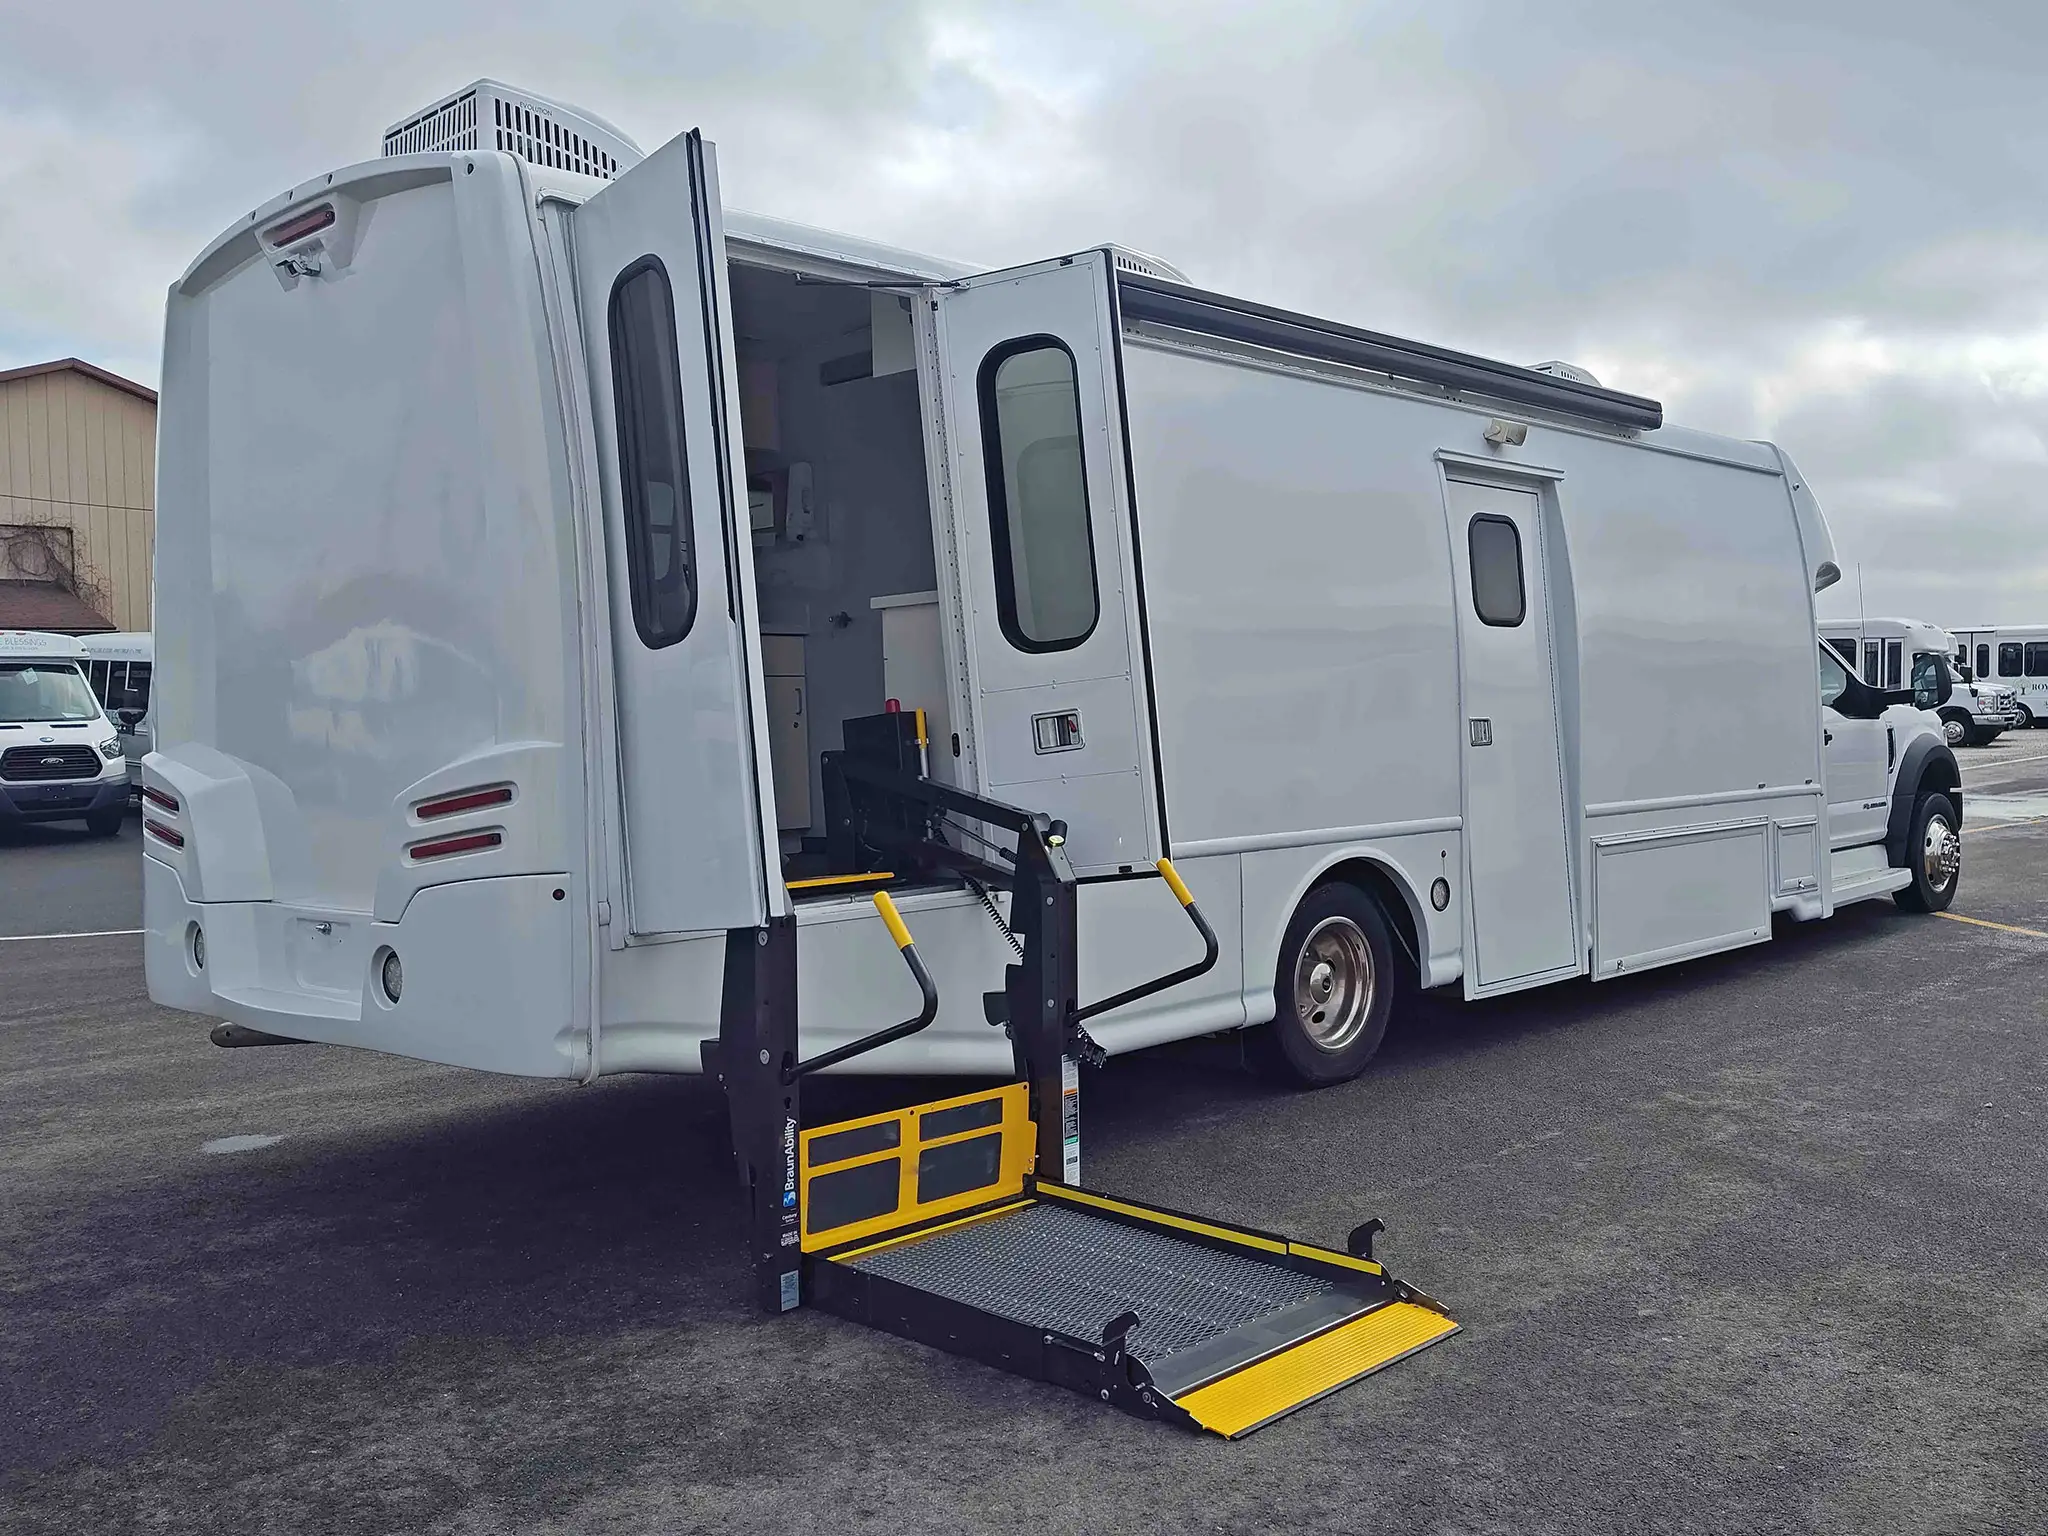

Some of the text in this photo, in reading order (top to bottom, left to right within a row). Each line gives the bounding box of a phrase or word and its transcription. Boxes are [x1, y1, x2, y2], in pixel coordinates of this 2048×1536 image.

[519, 101, 553, 116] EVOLUTION
[4, 636, 47, 646] BLESSINGS
[784, 1117, 796, 1191] BraunAbility
